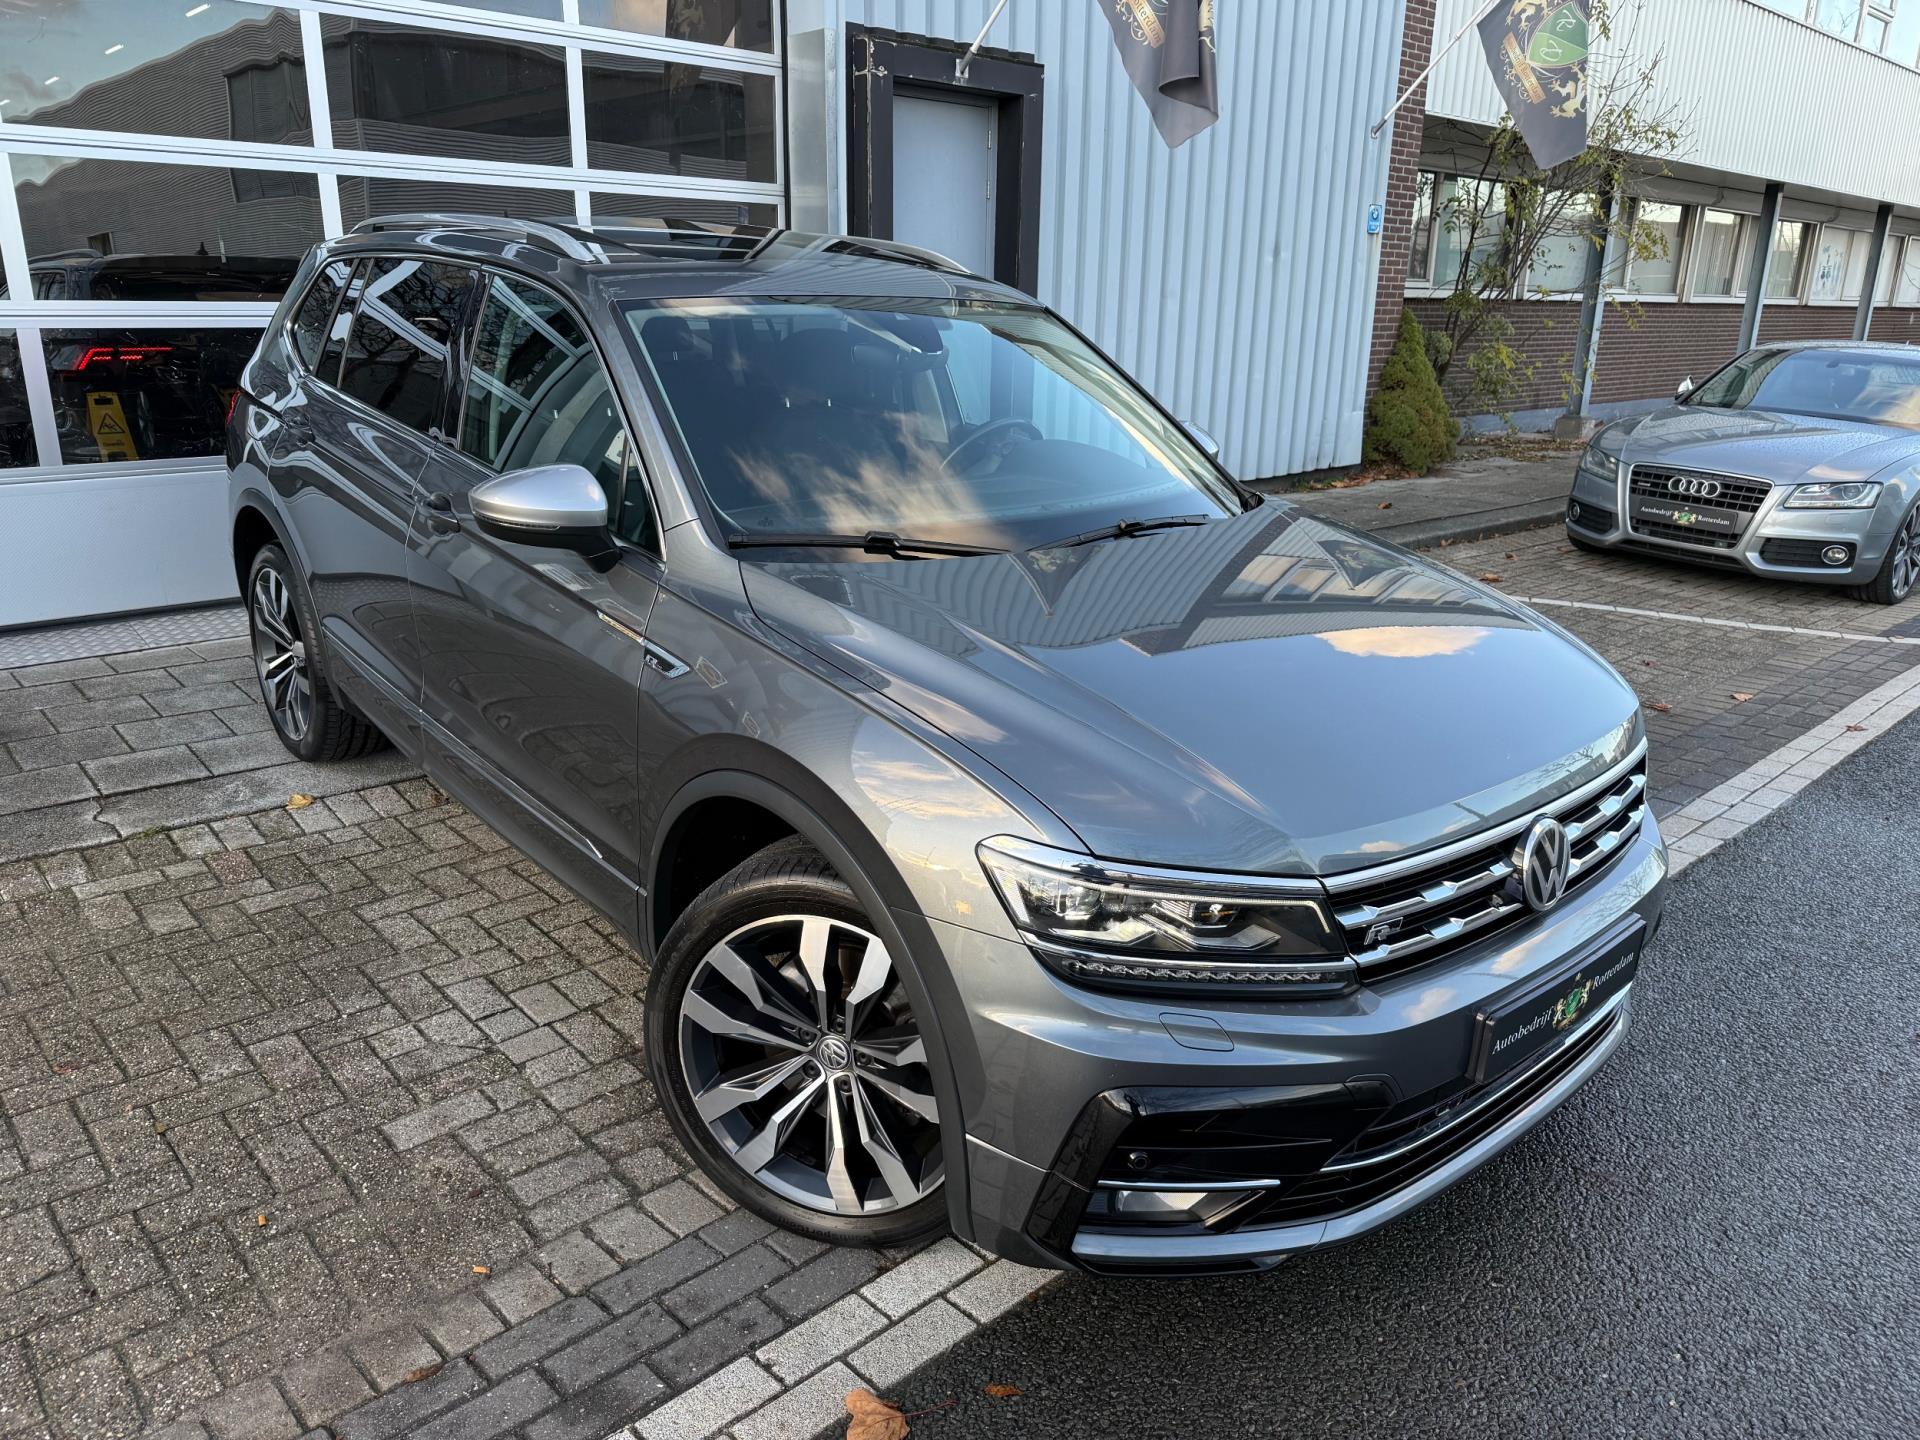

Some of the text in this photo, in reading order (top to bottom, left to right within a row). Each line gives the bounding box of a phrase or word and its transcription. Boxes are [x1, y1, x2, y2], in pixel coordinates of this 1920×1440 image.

[1132, 0, 1161, 43] otterdam
[1697, 514, 1730, 525] Rotterdam
[1491, 951, 1635, 1055] Autobedrijf Rotterdam
